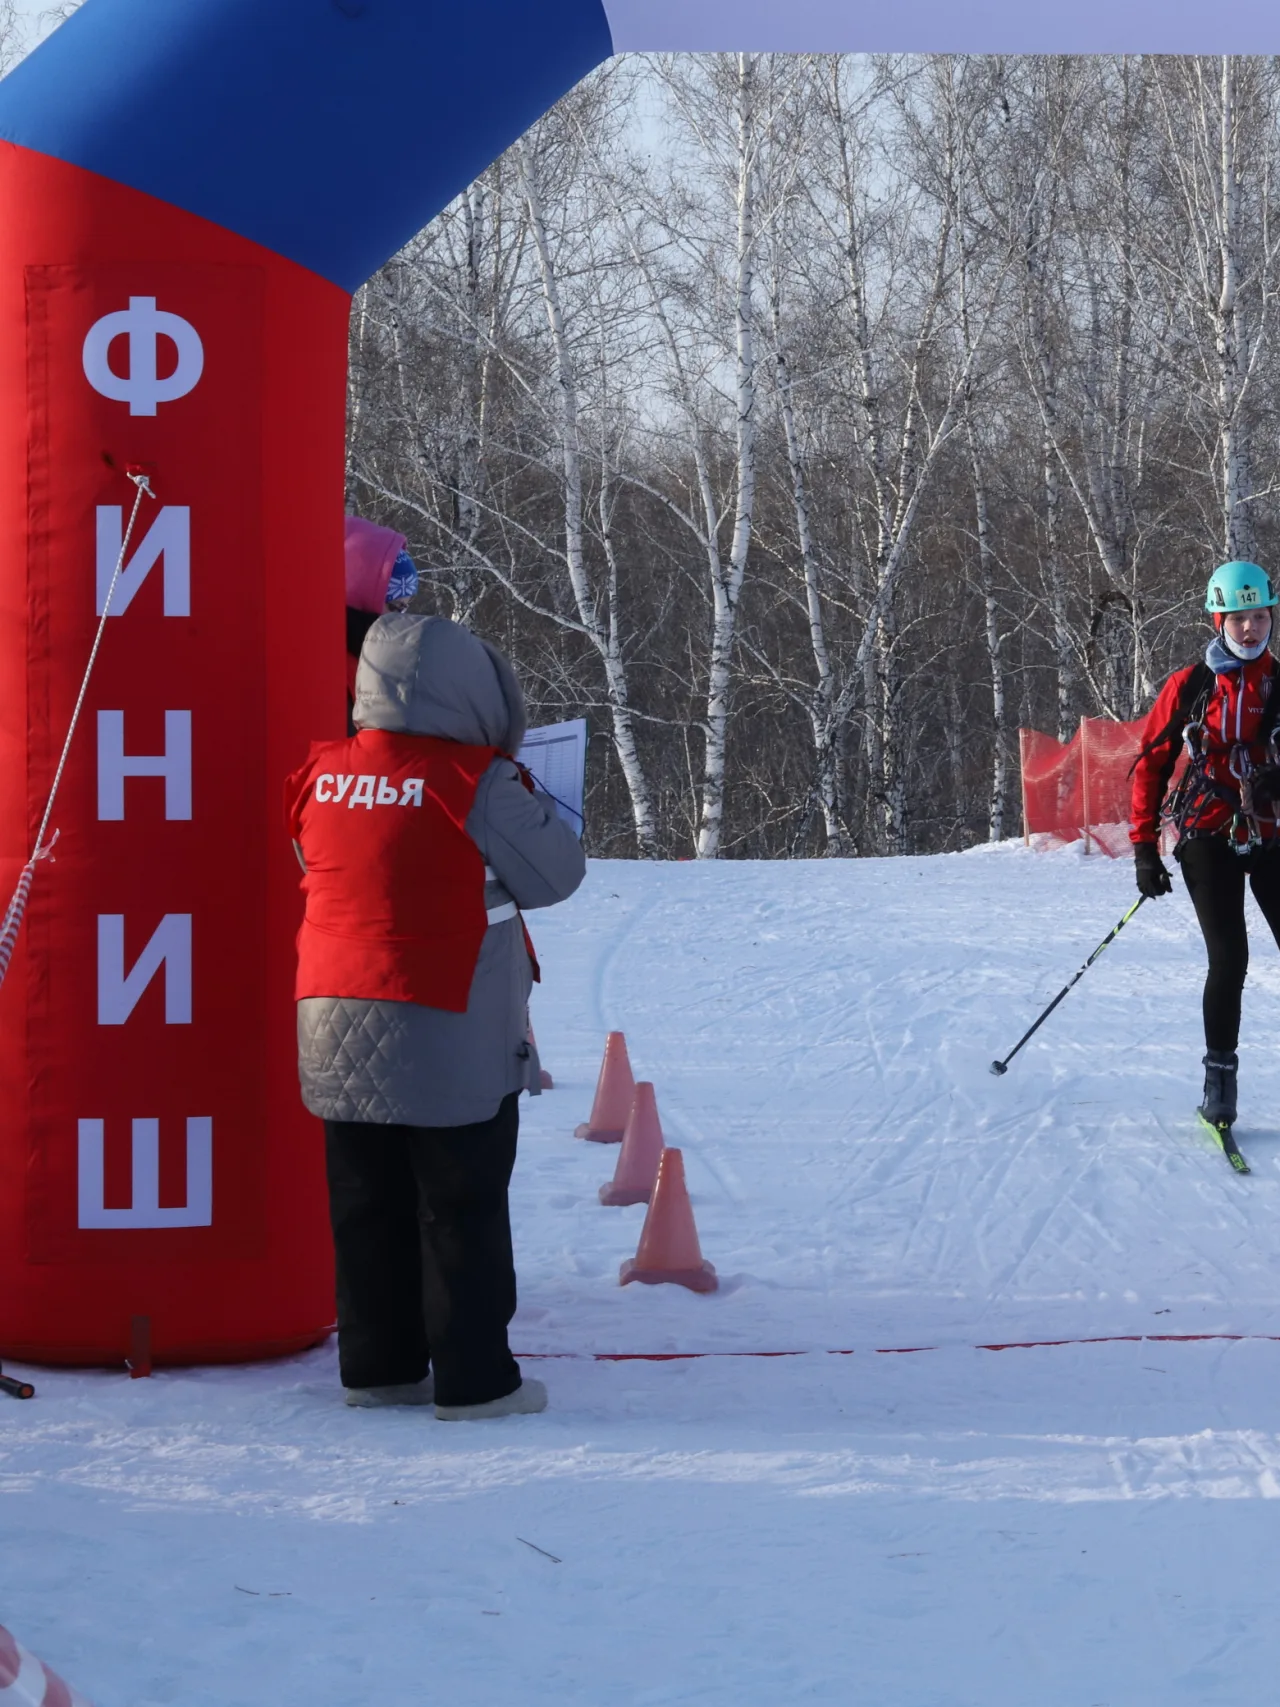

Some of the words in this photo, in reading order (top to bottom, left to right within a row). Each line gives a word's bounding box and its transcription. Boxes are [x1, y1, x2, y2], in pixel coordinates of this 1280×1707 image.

[1241, 592, 1256, 603] 147
[79, 297, 211, 1228] ФИНИШ
[315, 773, 425, 810] СУДЬЯ
